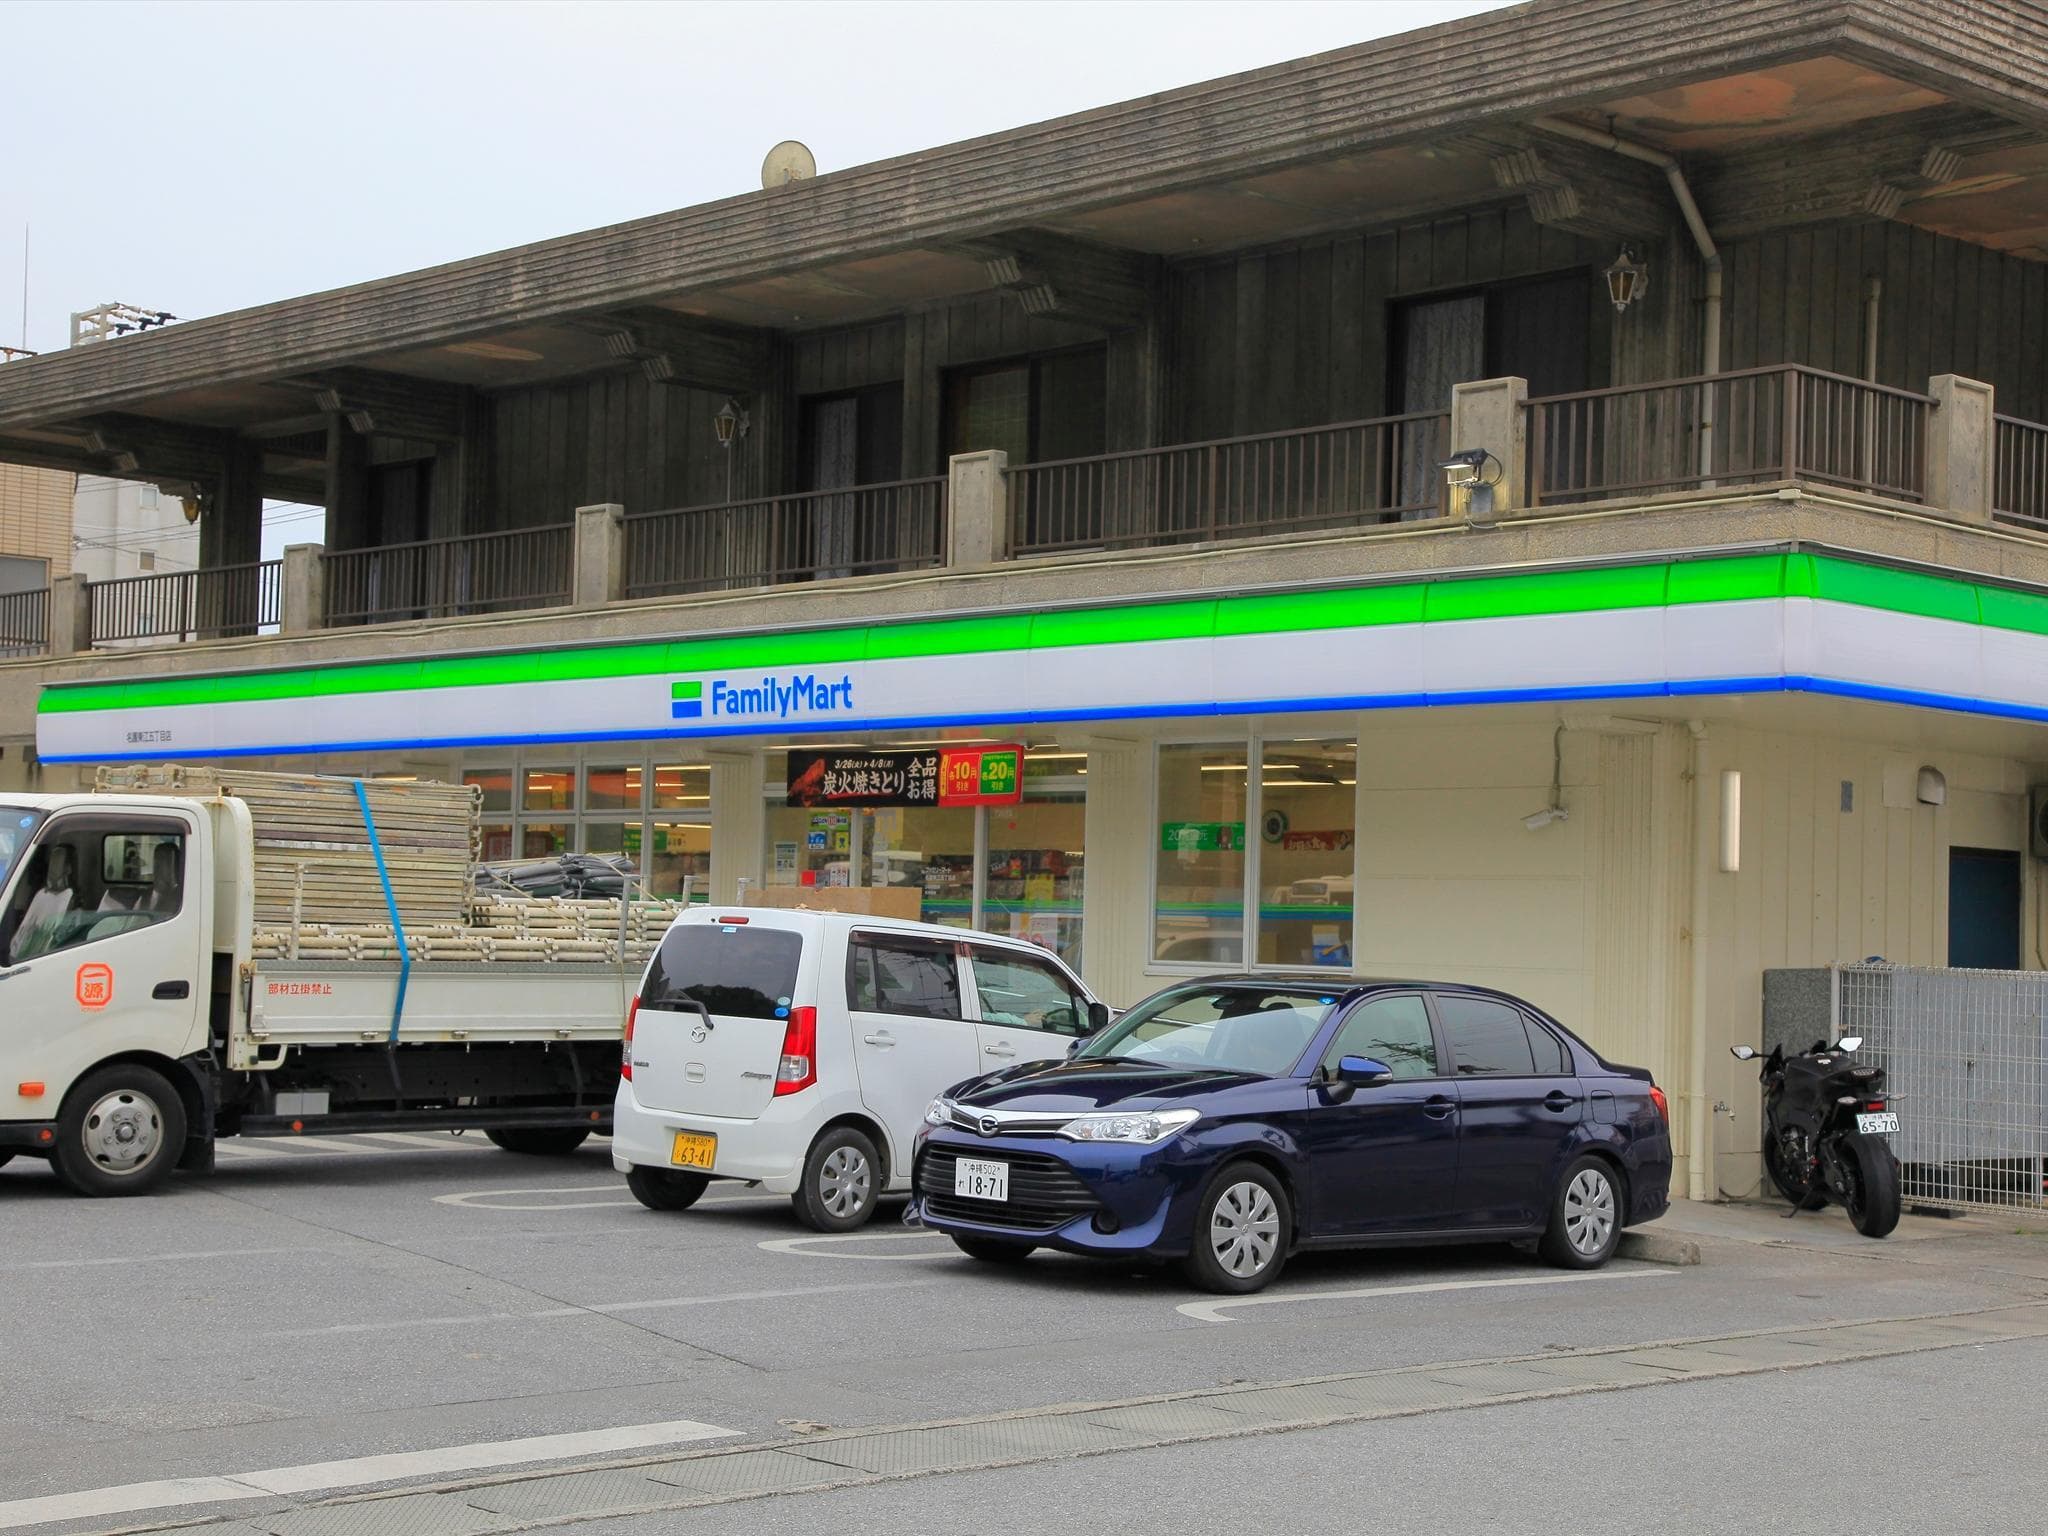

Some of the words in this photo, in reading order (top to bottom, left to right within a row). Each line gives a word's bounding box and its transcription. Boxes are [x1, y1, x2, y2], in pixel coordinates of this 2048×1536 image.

[712, 675, 853, 717] FamilyMart
[907, 757, 937, 778] 全品
[822, 770, 905, 796] 炭火焼きとり
[907, 778, 937, 800] お得
[268, 983, 332, 995] 部材立掛禁止
[1862, 1120, 1898, 1132] 65-70
[681, 1147, 711, 1166] 63-41
[969, 1175, 1003, 1198] 18-71
